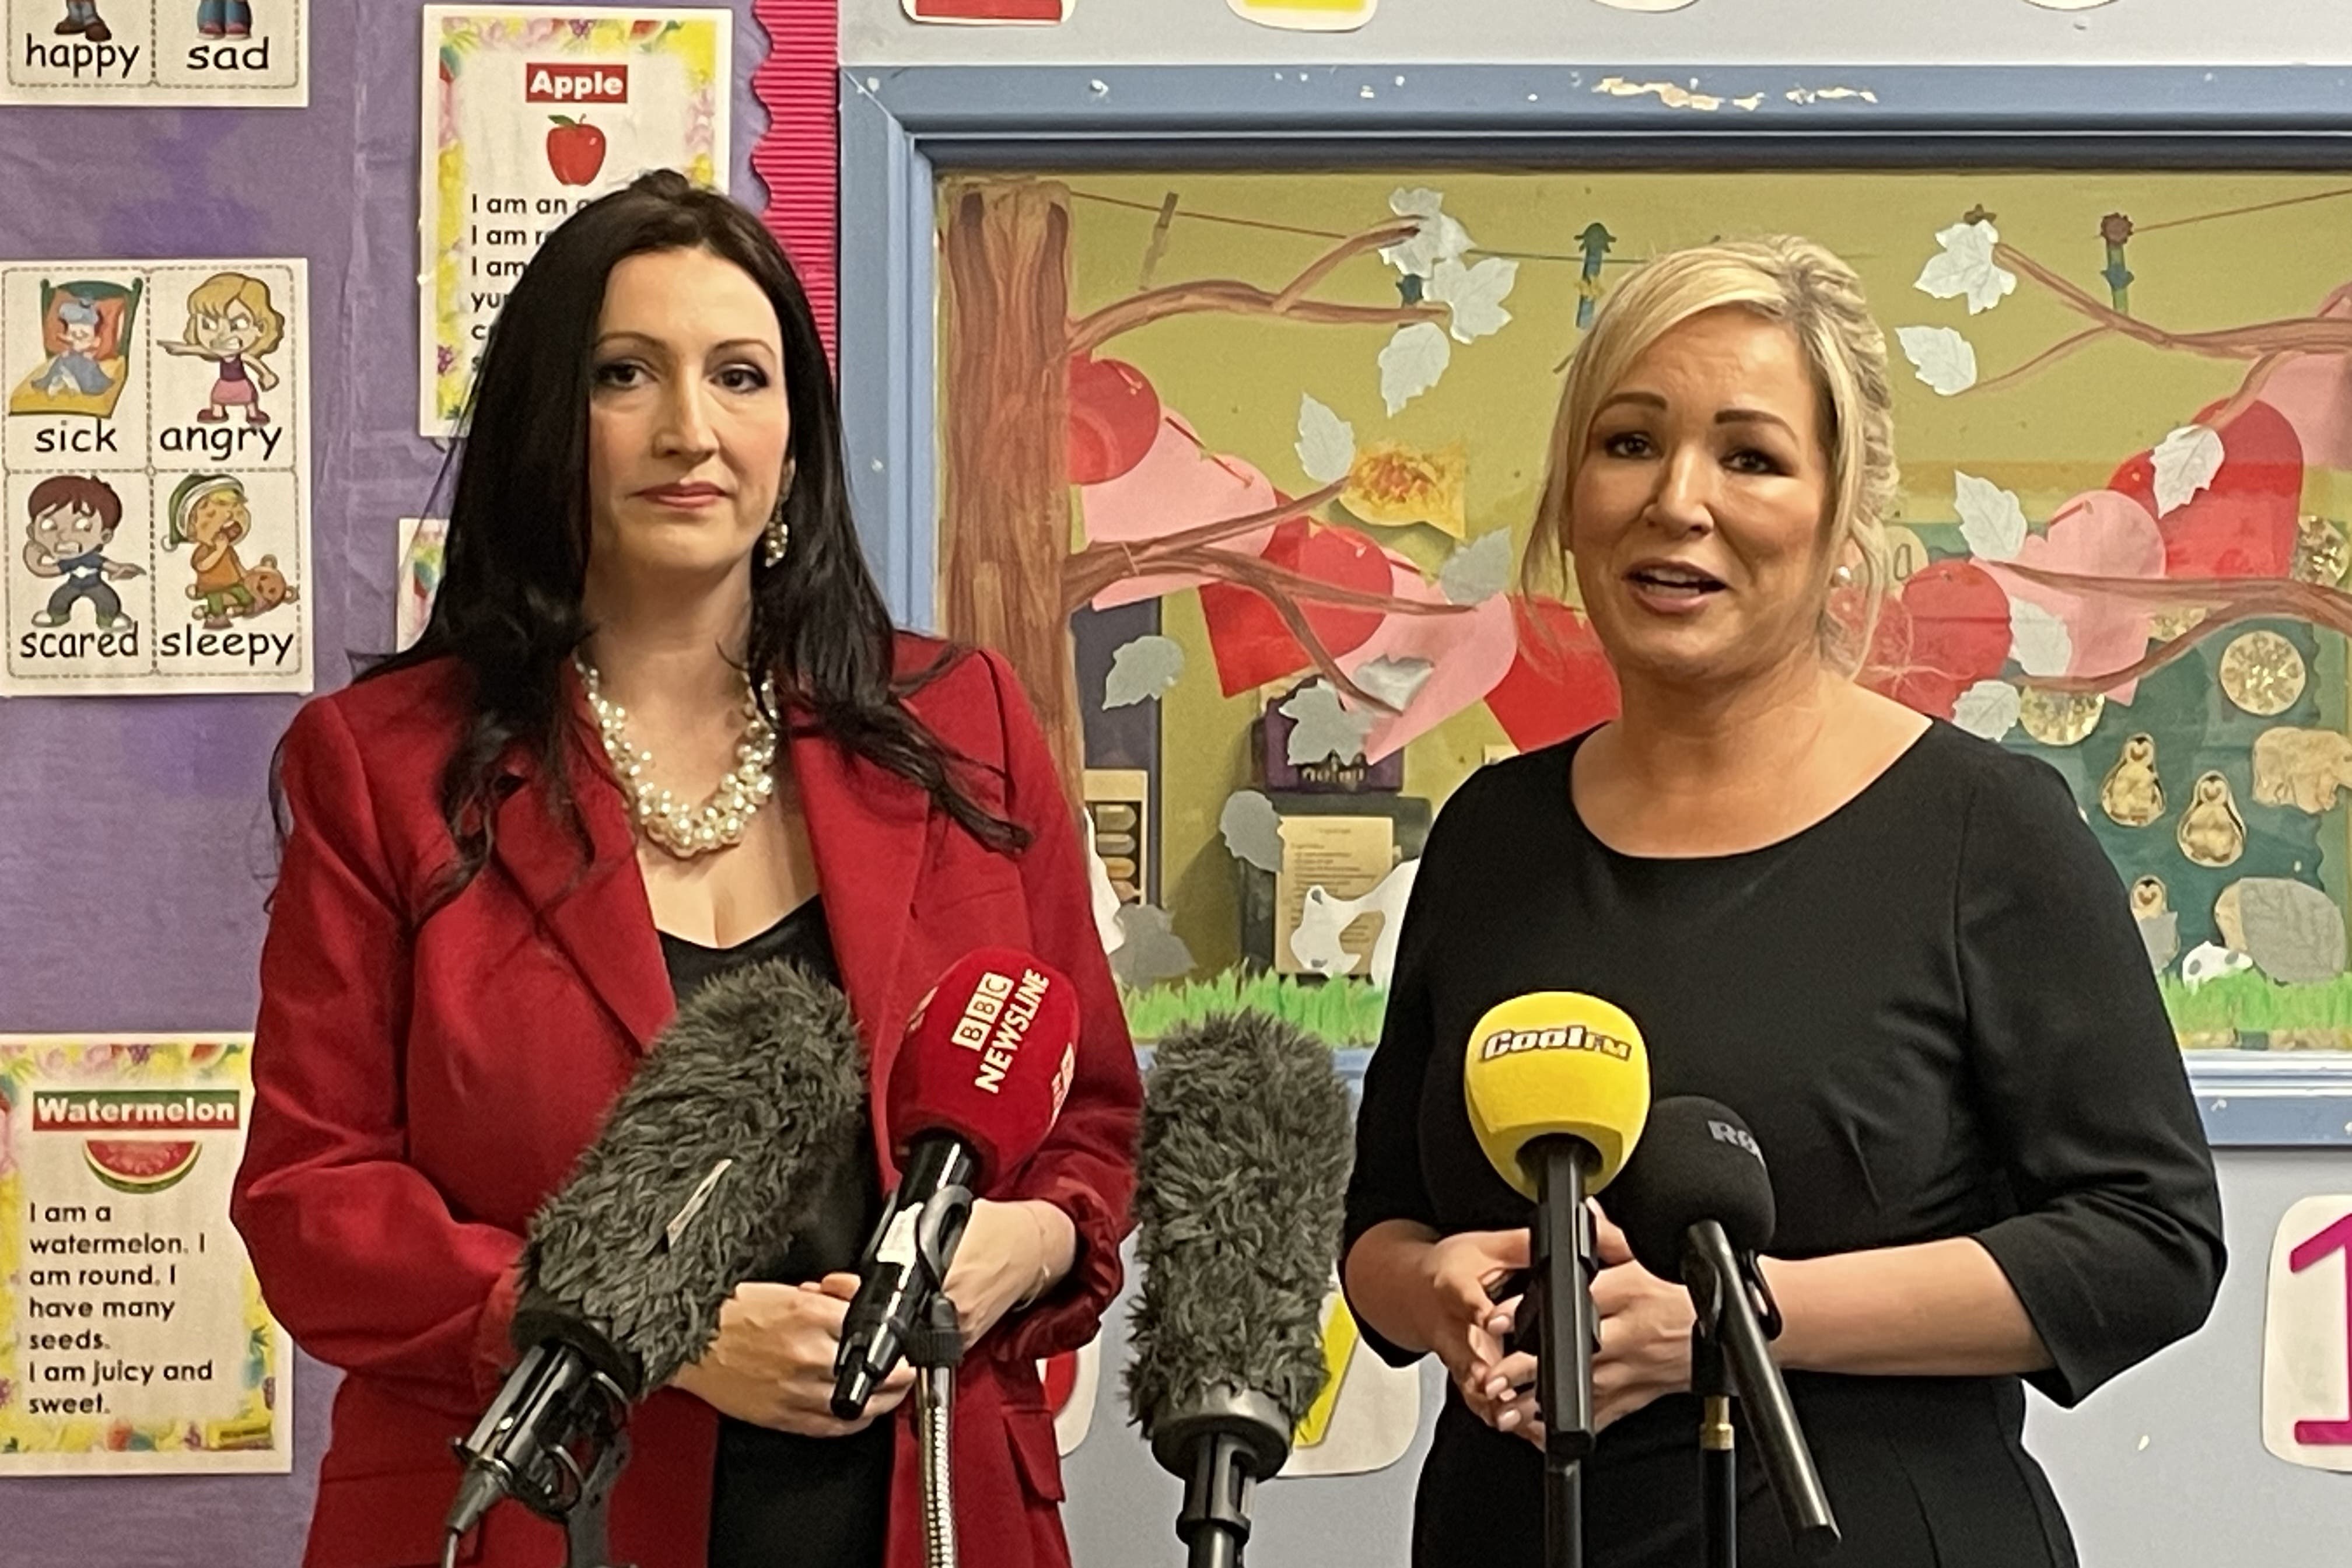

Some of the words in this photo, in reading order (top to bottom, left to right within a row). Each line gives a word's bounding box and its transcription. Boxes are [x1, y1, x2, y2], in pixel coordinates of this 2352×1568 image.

[26, 33, 141, 79] happy
[186, 36, 270, 71] sad
[530, 70, 624, 100] Apple
[472, 193, 478, 214] I
[487, 198, 527, 214] am
[536, 198, 568, 214] an
[472, 225, 478, 246] I
[486, 229, 527, 245] am
[472, 256, 478, 276] I
[487, 261, 527, 276] am
[34, 419, 118, 453] sick
[160, 426, 282, 461] angry
[20, 622, 139, 659] scared
[160, 623, 294, 666] sleepy
[954, 974, 1012, 1048] BBC
[974, 968, 1050, 1094] NEWSLINE
[37, 1097, 235, 1123] Watermelon
[30, 1202, 36, 1223] I
[45, 1206, 86, 1223] am
[96, 1206, 111, 1222] a
[29, 1232, 189, 1254] watermelon.
[200, 1233, 205, 1253] I
[29, 1270, 71, 1286] am
[79, 1264, 161, 1286] round.
[170, 1264, 176, 1285] I
[29, 1297, 93, 1318] have
[103, 1301, 176, 1322] many
[29, 1329, 111, 1350] seeds.
[29, 1361, 35, 1383] I
[44, 1366, 85, 1381] am
[92, 1360, 155, 1387] juicy
[163, 1360, 213, 1381] and
[29, 1394, 111, 1415] sweet.
